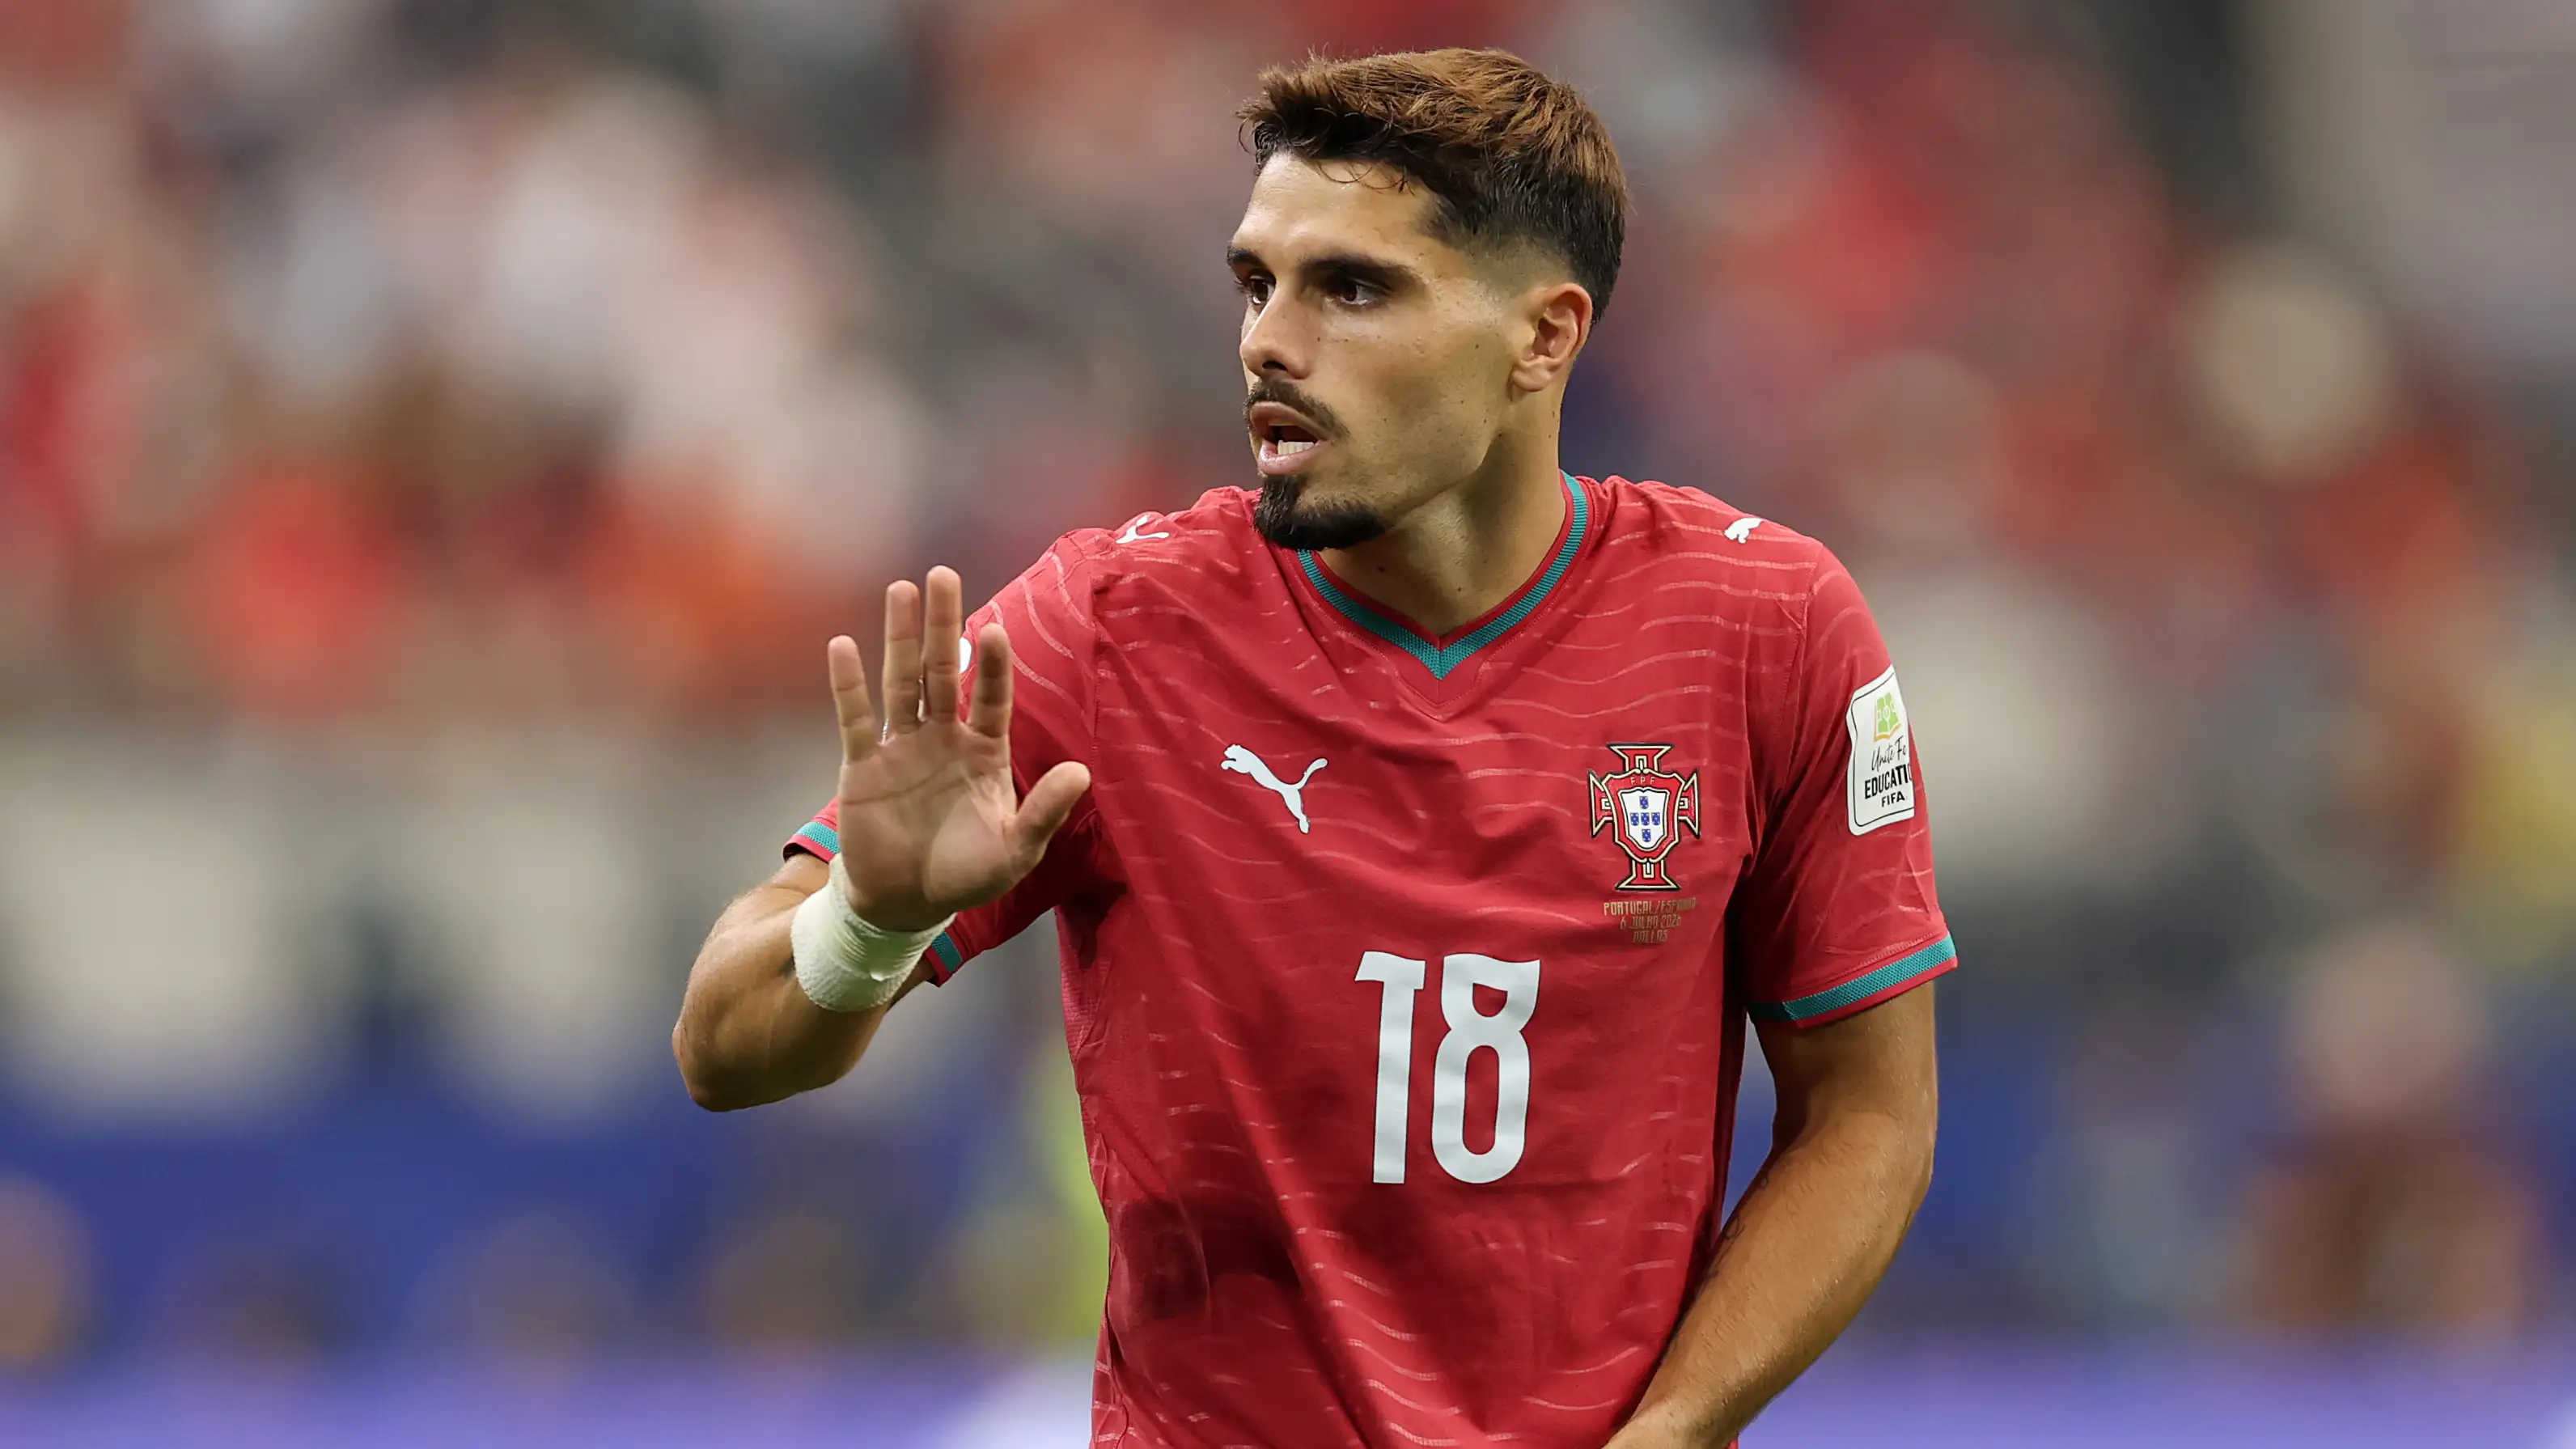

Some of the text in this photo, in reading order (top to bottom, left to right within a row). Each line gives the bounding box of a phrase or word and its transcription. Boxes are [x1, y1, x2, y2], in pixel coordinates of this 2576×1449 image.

[1871, 743, 1895, 772] Unite
[1630, 777, 1656, 785] FPF
[1882, 790, 1905, 807] FIFA
[1621, 916, 1627, 930] 6
[1354, 951, 1540, 1184] 18
